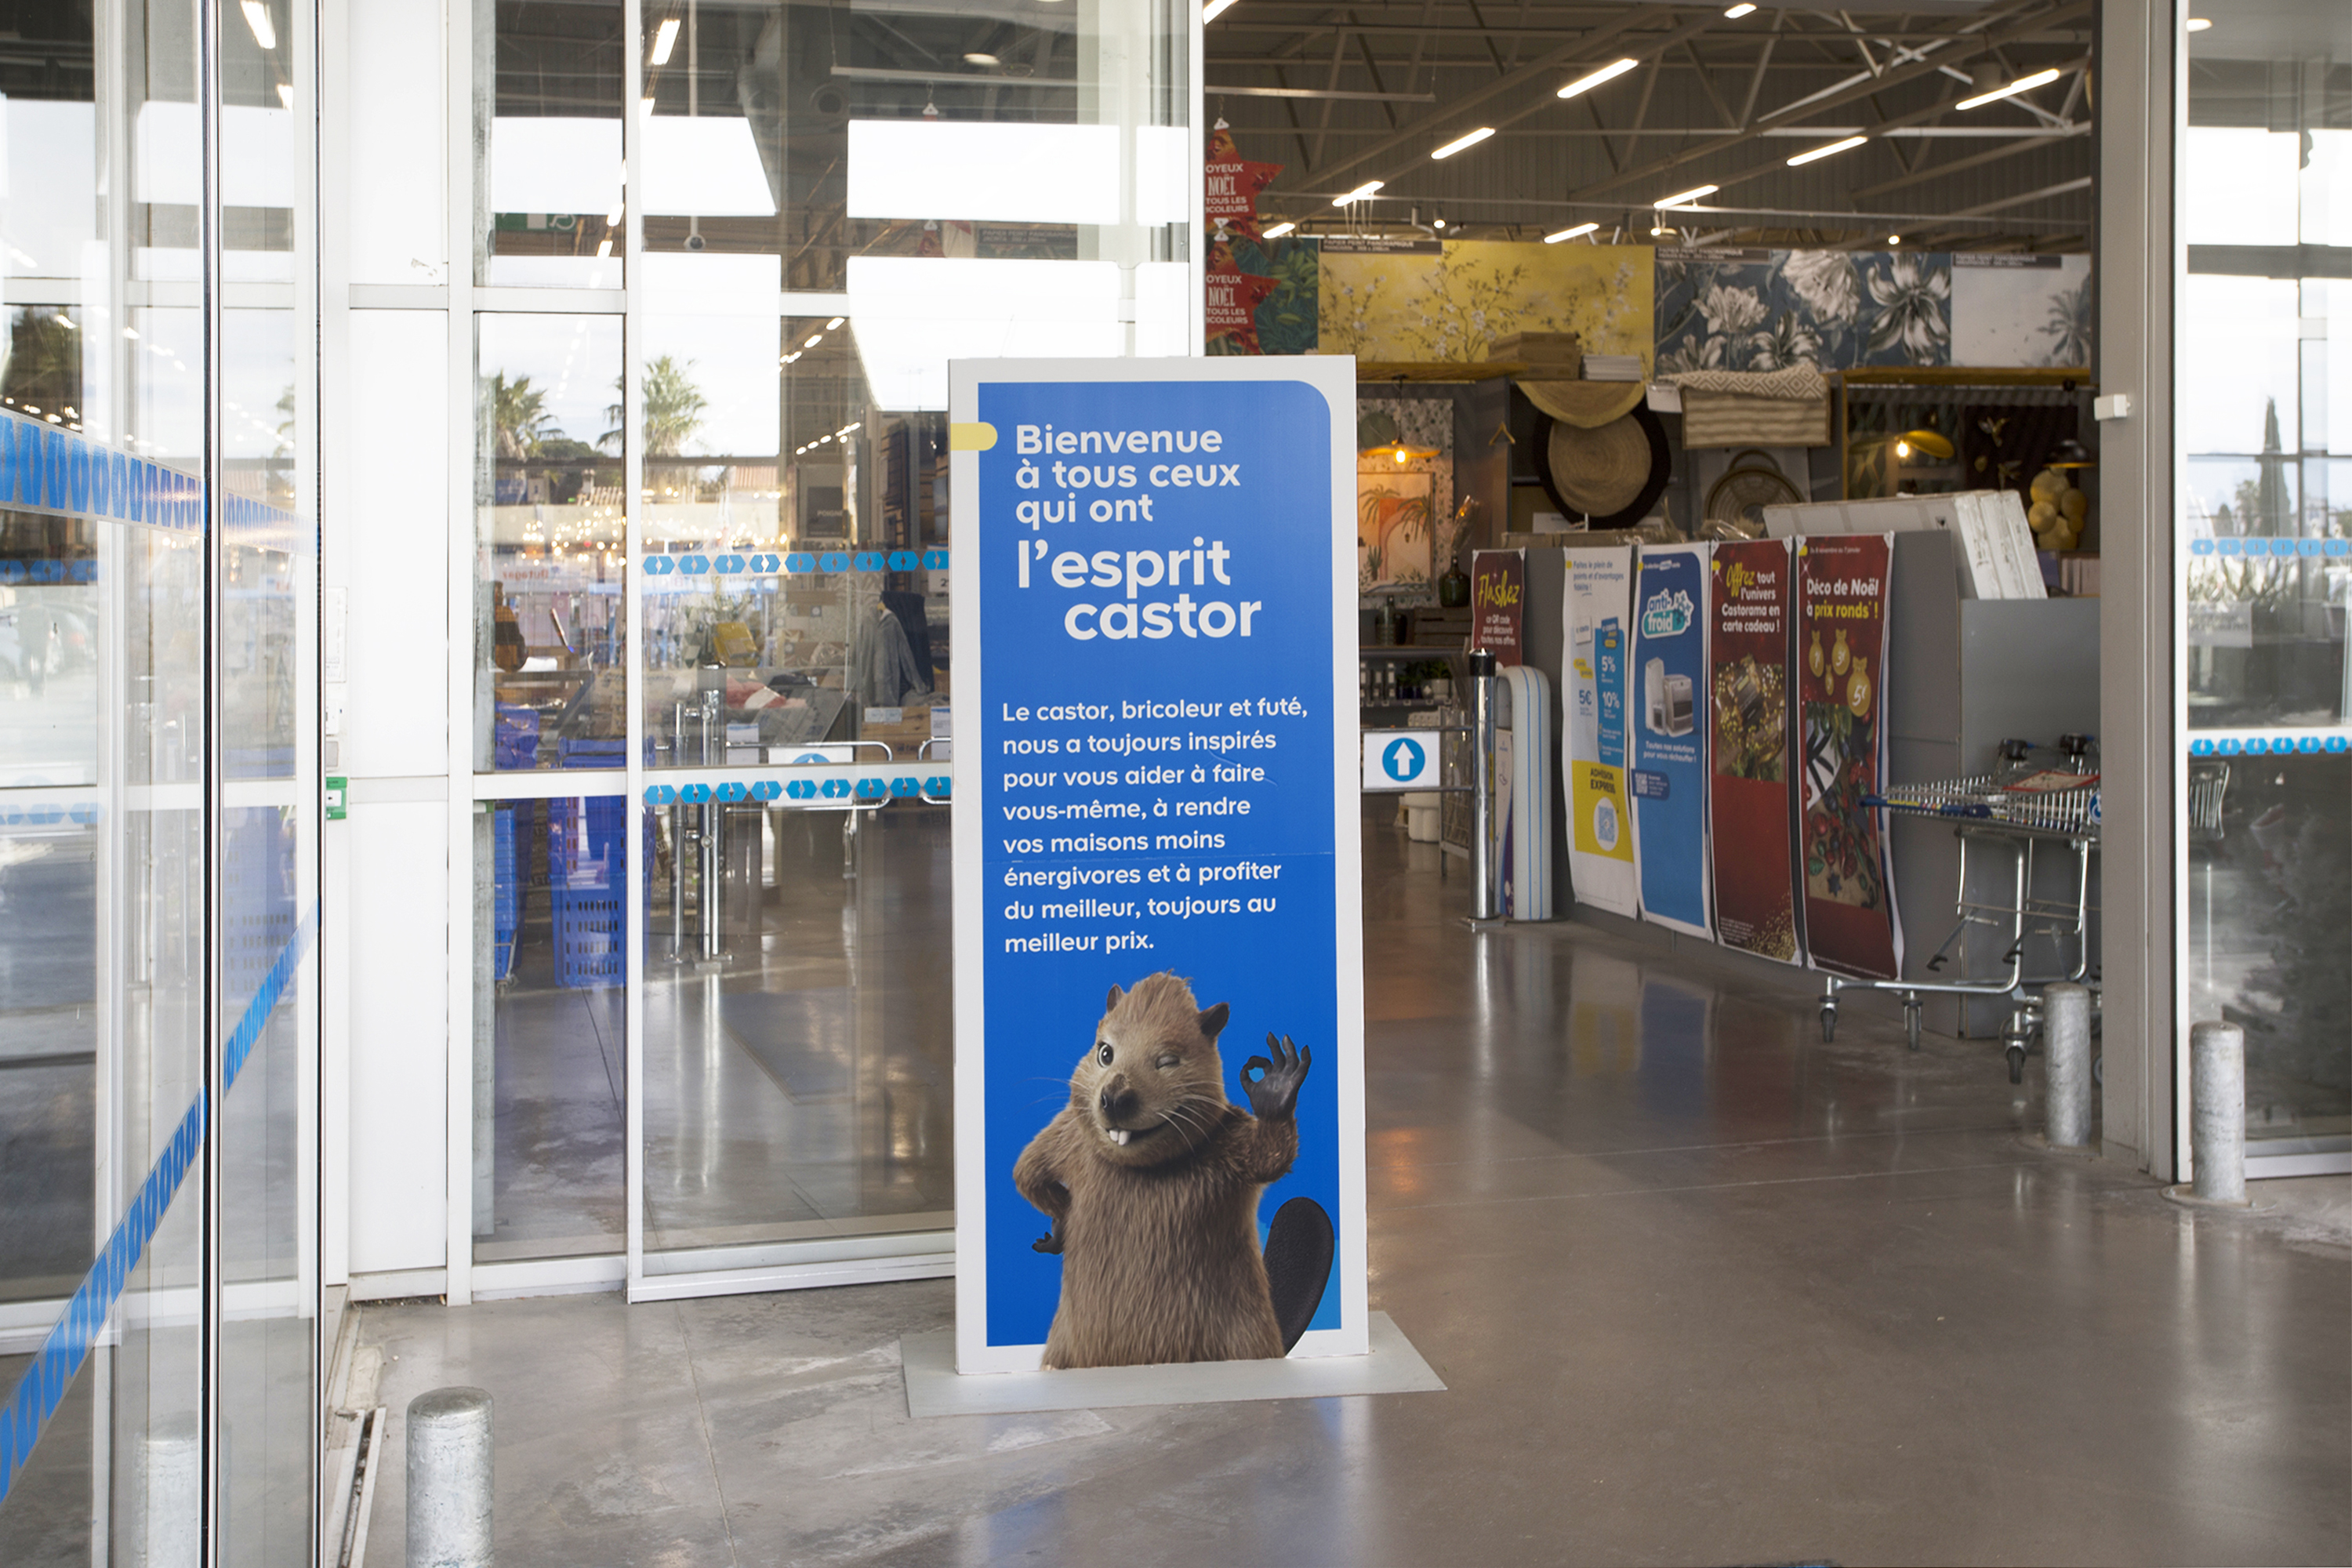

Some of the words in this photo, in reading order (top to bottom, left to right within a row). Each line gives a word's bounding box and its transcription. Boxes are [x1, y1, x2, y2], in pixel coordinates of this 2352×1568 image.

[1205, 163, 1243, 173] OYEUX
[1208, 173, 1236, 196] NOËL
[1206, 274, 1243, 284] OYEUX
[1208, 284, 1236, 307] NOËL
[1016, 423, 1223, 455] Bienvenue
[1015, 458, 1040, 489] à
[1051, 460, 1138, 488] tous
[1149, 464, 1241, 488] ceux
[1015, 492, 1076, 531] qui
[1089, 494, 1153, 523] ont
[1018, 535, 1231, 599] l'esprit
[940, 577, 949, 587] 2
[1478, 570, 1520, 608] Flashez
[1726, 561, 1755, 597] Offrez
[1757, 571, 1775, 584] tout
[1806, 578, 1831, 596] Déco
[1833, 579, 1848, 596] de
[1850, 578, 1879, 596] Noël
[1649, 591, 1671, 612] anti-
[1740, 586, 1776, 601] l'univers
[1064, 593, 1262, 641] castor
[1722, 603, 1767, 617] Castorama
[1769, 605, 1780, 617] en
[1806, 599, 1813, 617] à
[1814, 599, 1833, 621] prix
[1647, 612, 1673, 632] froid
[1722, 619, 1743, 633] carte
[1744, 619, 1775, 633] cadeau
[1601, 655, 1616, 673] 5%
[1003, 702, 1030, 721] Le
[1036, 702, 1115, 722] castor,
[1122, 699, 1223, 719] bricoleur
[1229, 699, 1252, 717] et
[1257, 696, 1308, 718] futé,
[1578, 691, 1592, 705] 5€
[1602, 691, 1620, 709] 10%
[1004, 739, 1059, 754] nous
[1065, 739, 1080, 753] a
[1087, 733, 1181, 757] toujours
[1189, 729, 1276, 754] inspirés
[1004, 772, 1058, 792] pour
[1063, 771, 1118, 786] vous
[1125, 765, 1185, 785] aider
[1190, 764, 1205, 783] à
[1212, 763, 1265, 782] faire
[1003, 799, 1147, 821] vous-même,
[1152, 797, 1167, 817] à
[1176, 796, 1250, 816] rendre
[1003, 838, 1044, 854] vos
[1051, 833, 1149, 852] maisons
[1156, 830, 1225, 850] moins
[1004, 866, 1141, 890] énergivores
[1148, 865, 1171, 883] et
[1176, 862, 1190, 882] à
[1199, 861, 1282, 886] profiter
[1004, 901, 1033, 920] du
[1042, 898, 1141, 919] meilleur,
[1147, 896, 1241, 920] toujours
[1247, 898, 1276, 913] au
[1005, 932, 1098, 953] meilleur
[1105, 931, 1154, 954] prix.
